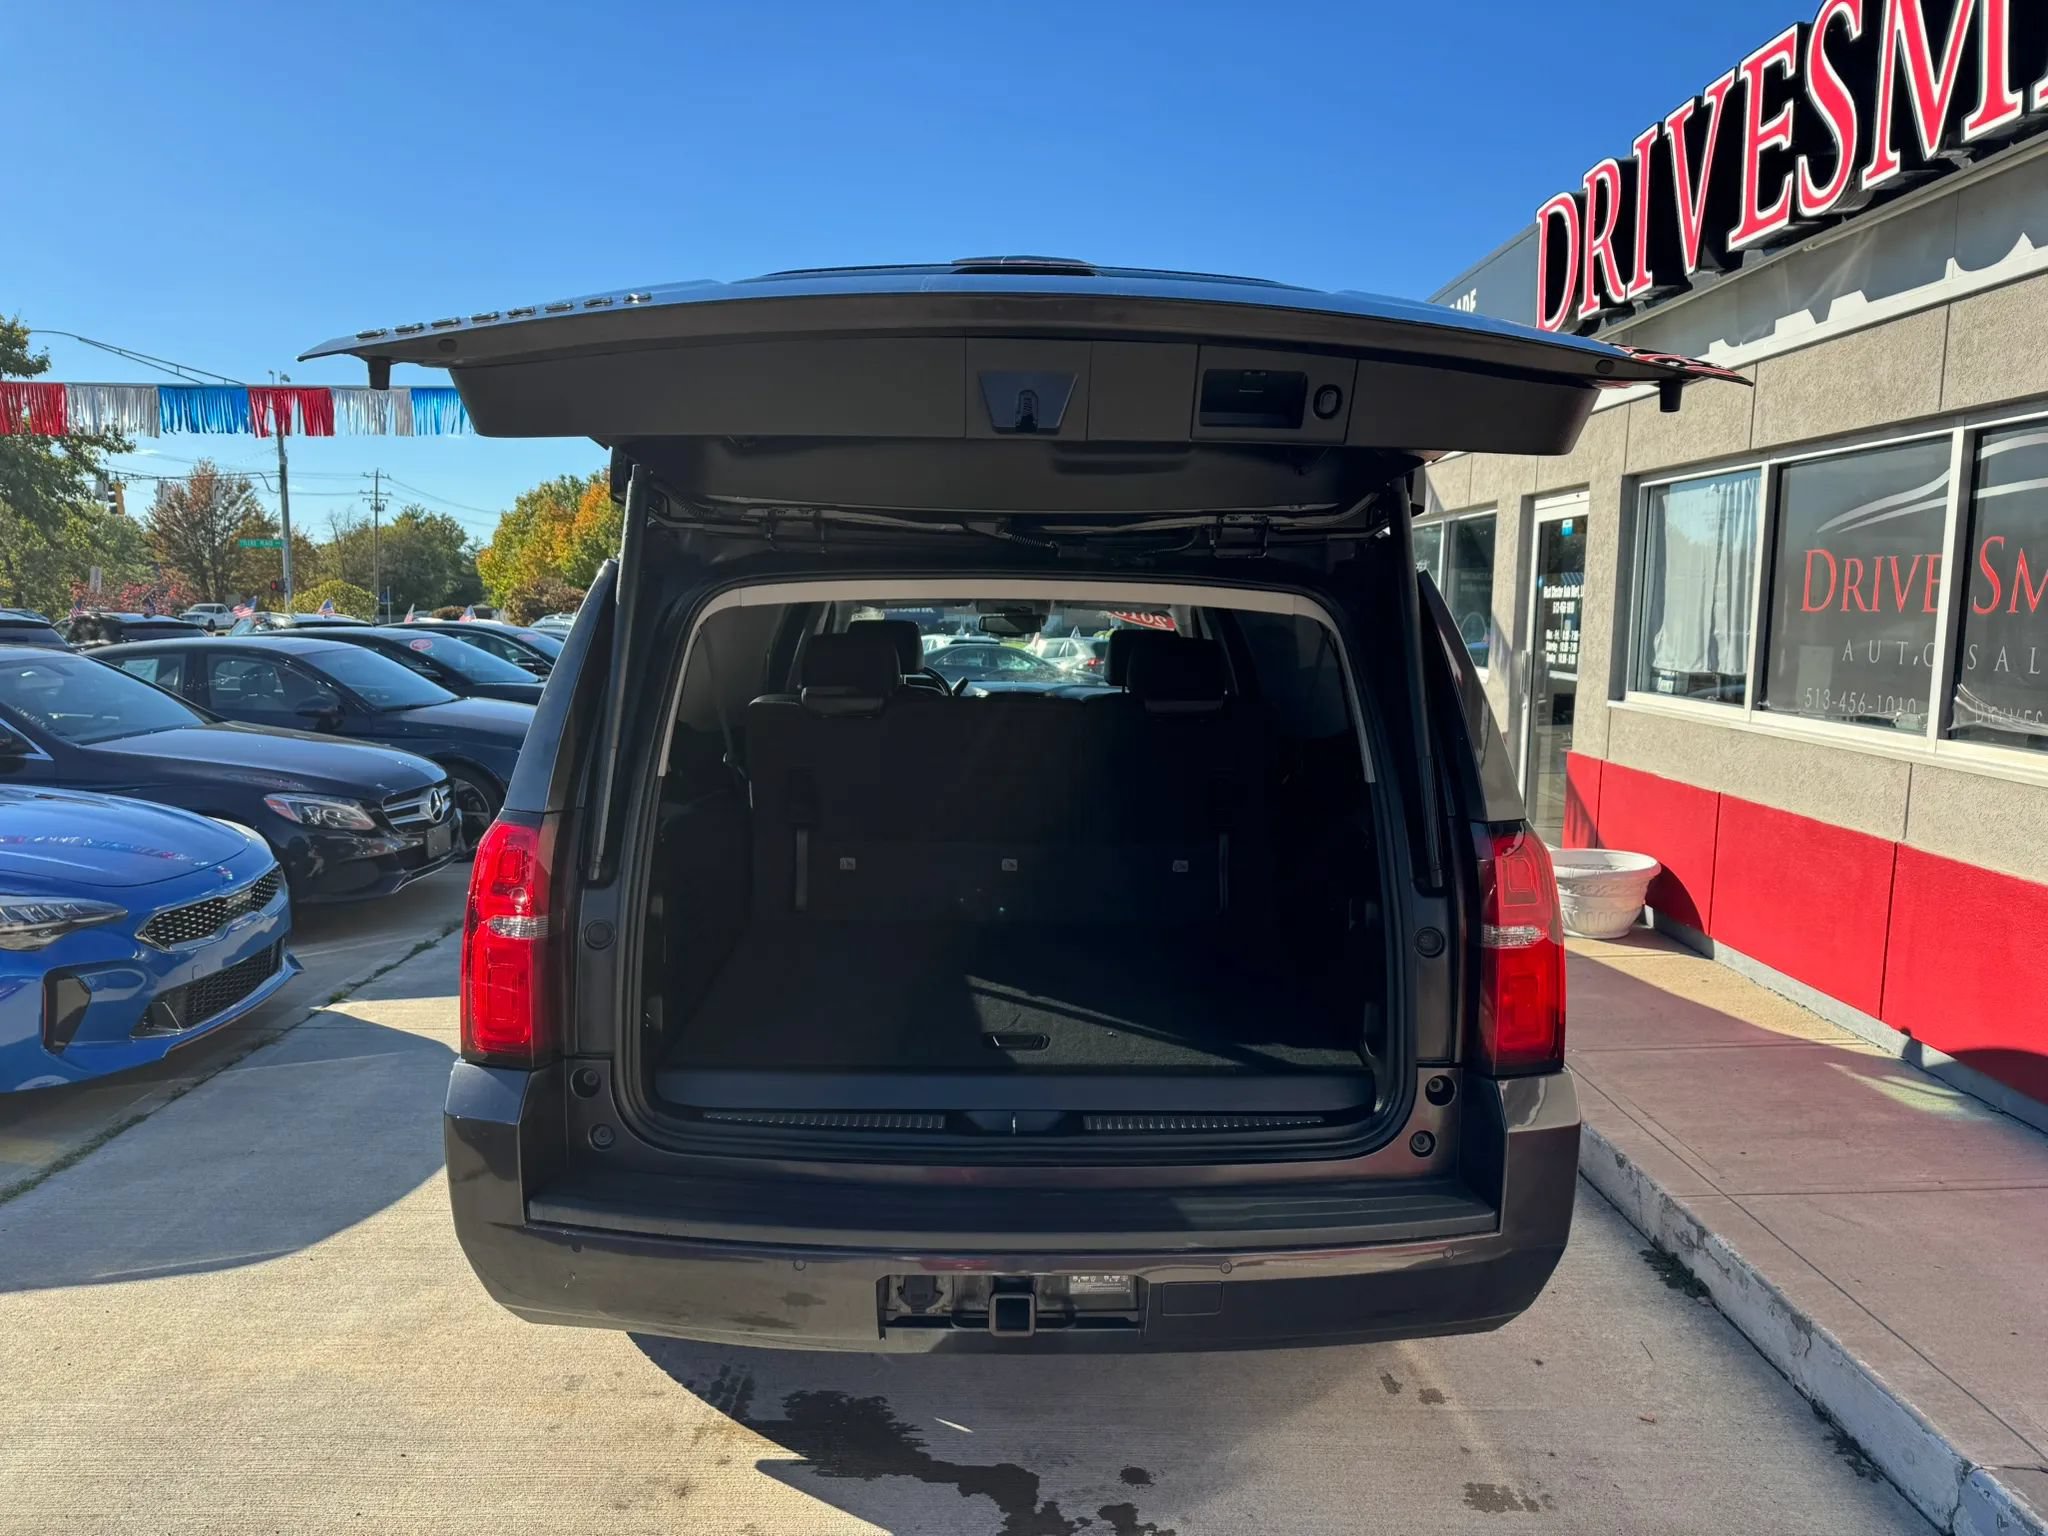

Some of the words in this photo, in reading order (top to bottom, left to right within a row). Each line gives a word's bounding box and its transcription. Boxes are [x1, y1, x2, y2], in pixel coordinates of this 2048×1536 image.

[1535, 0, 2048, 332] DRIVESM
[1800, 549, 1943, 613] DRIVE
[1804, 687, 1917, 714] 513-456-1010
